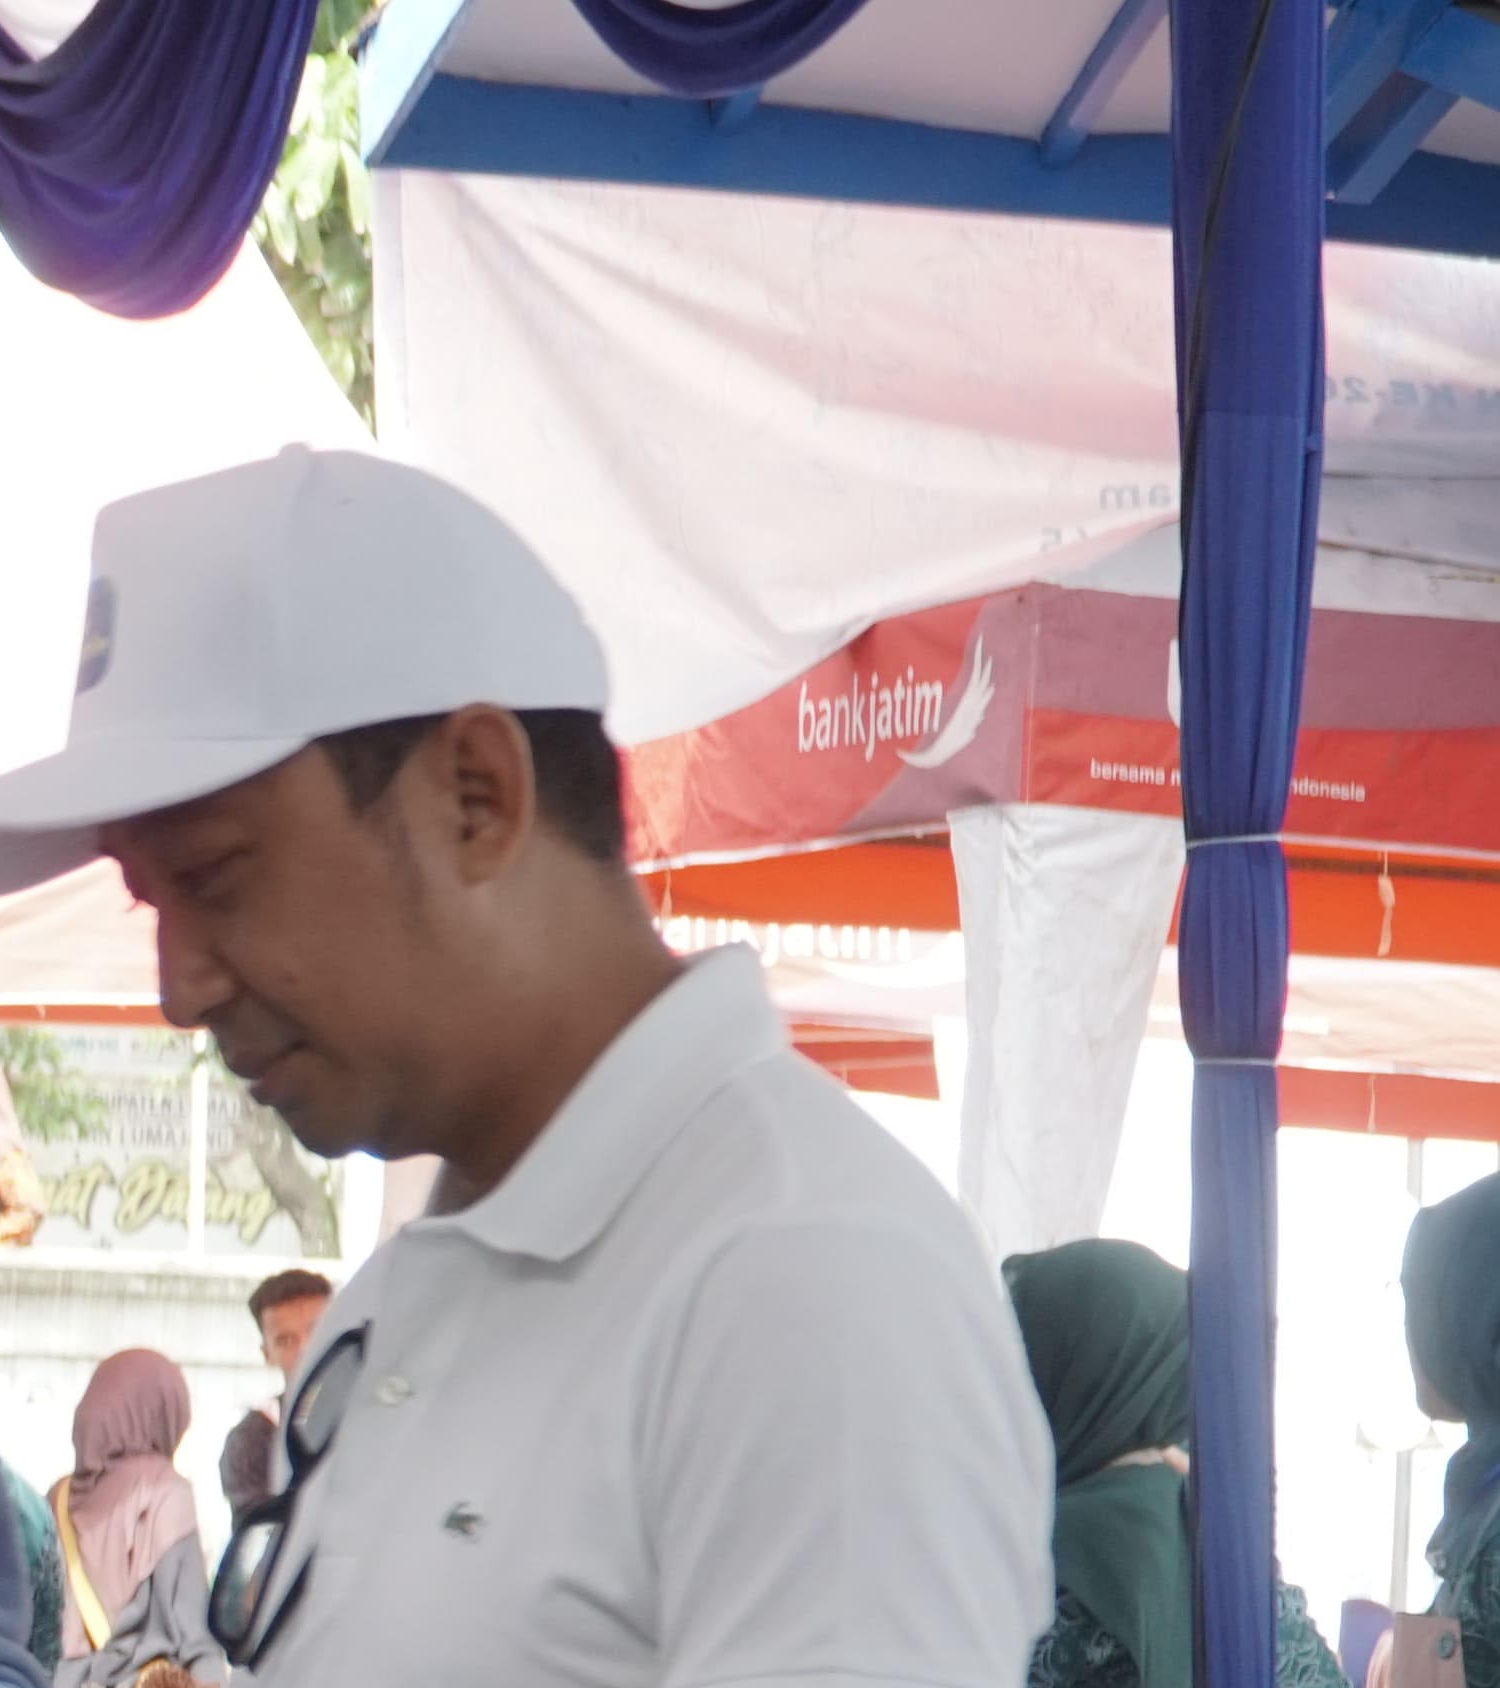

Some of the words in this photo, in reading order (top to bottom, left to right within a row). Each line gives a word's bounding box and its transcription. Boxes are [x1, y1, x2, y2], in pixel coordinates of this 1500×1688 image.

[799, 665, 943, 762] bankjatim
[1090, 758, 1165, 785] bersama
[1289, 778, 1366, 802] ndonesia
